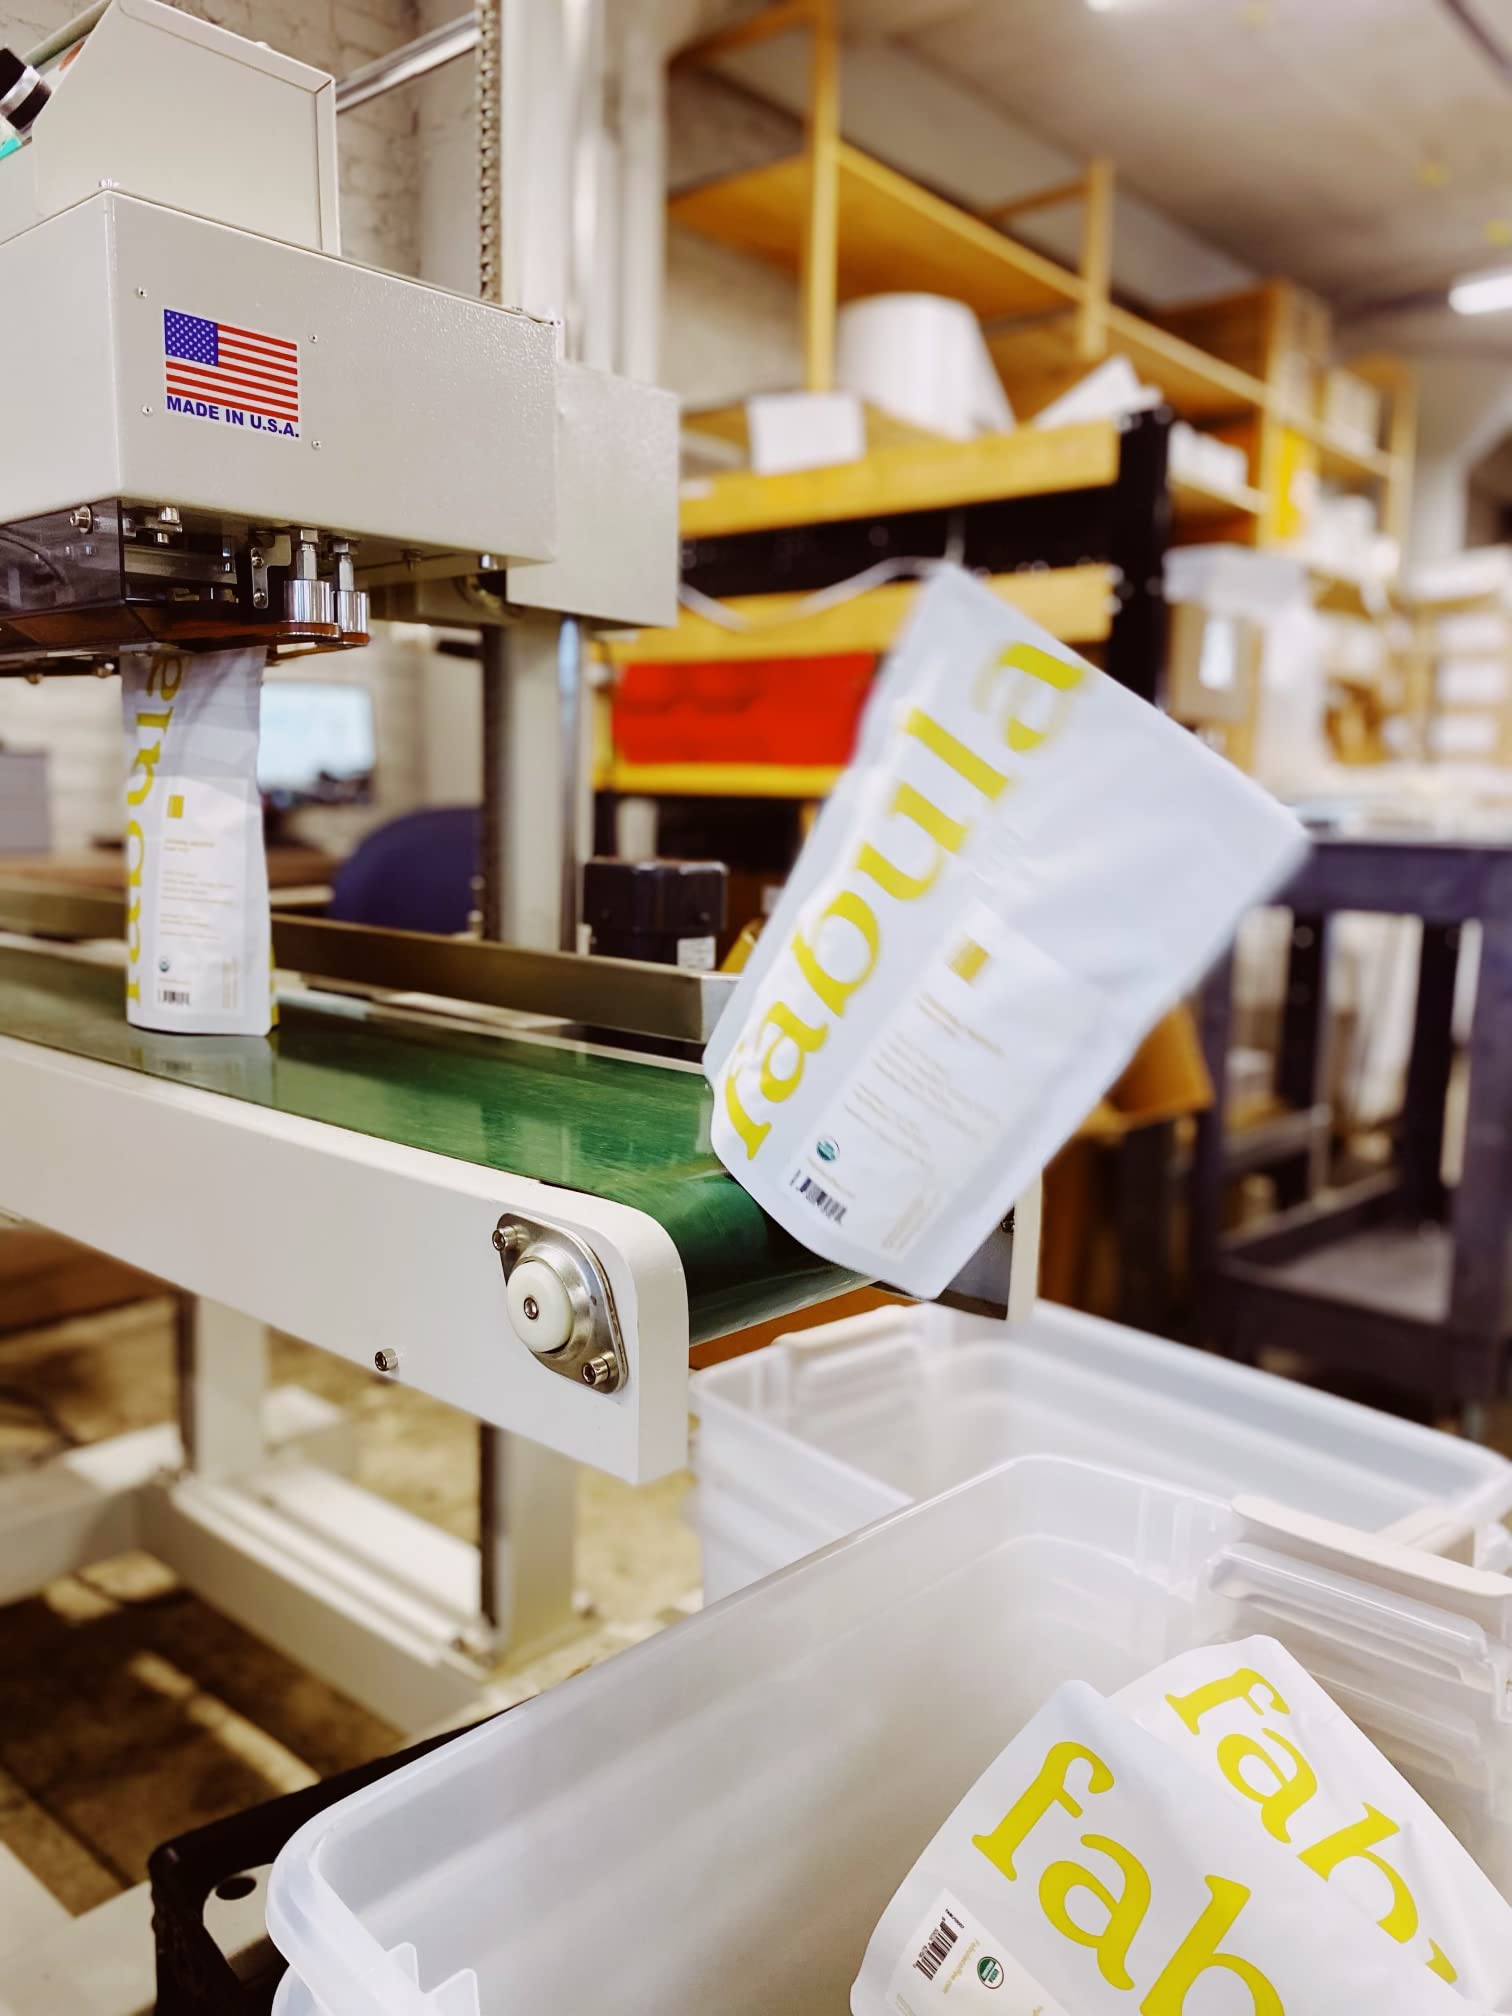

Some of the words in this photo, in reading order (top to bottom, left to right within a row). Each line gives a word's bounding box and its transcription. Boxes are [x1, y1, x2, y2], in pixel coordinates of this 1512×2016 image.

[167, 395, 220, 421] MADE
[225, 408, 244, 426] IN
[250, 414, 299, 438] U.S.A.
[712, 641, 1090, 1160] fabula
